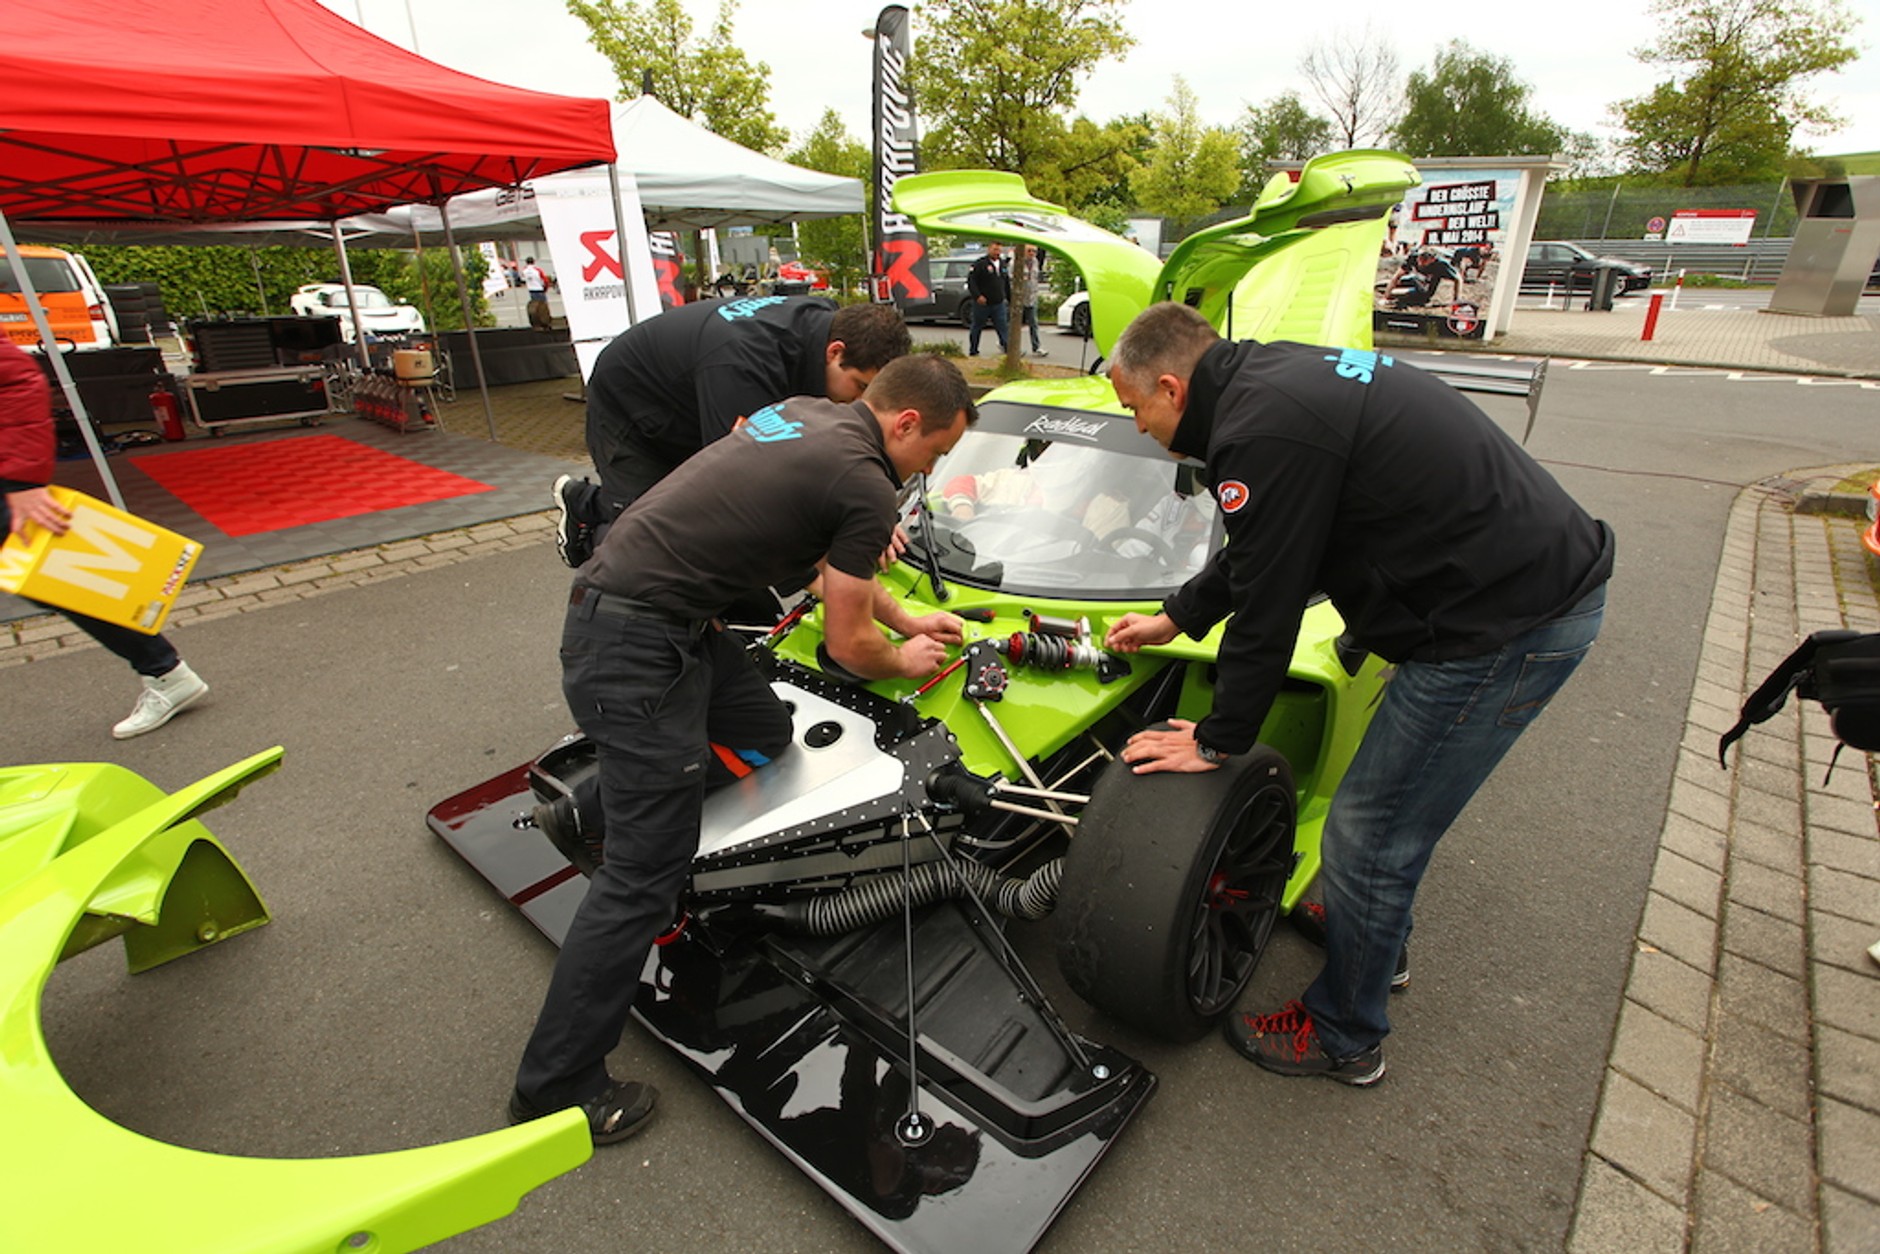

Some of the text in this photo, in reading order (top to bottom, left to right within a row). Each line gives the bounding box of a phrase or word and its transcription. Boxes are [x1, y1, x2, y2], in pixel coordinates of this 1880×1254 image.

[1430, 185, 1490, 203] DER GRÖSSTE
[1448, 216, 1466, 229] DER
[1442, 231, 1460, 243] MAI
[1462, 230, 1484, 243] 2014
[584, 285, 627, 300] AKRAPOV
[1023, 414, 1109, 436] Radical
[38, 504, 158, 600] M
